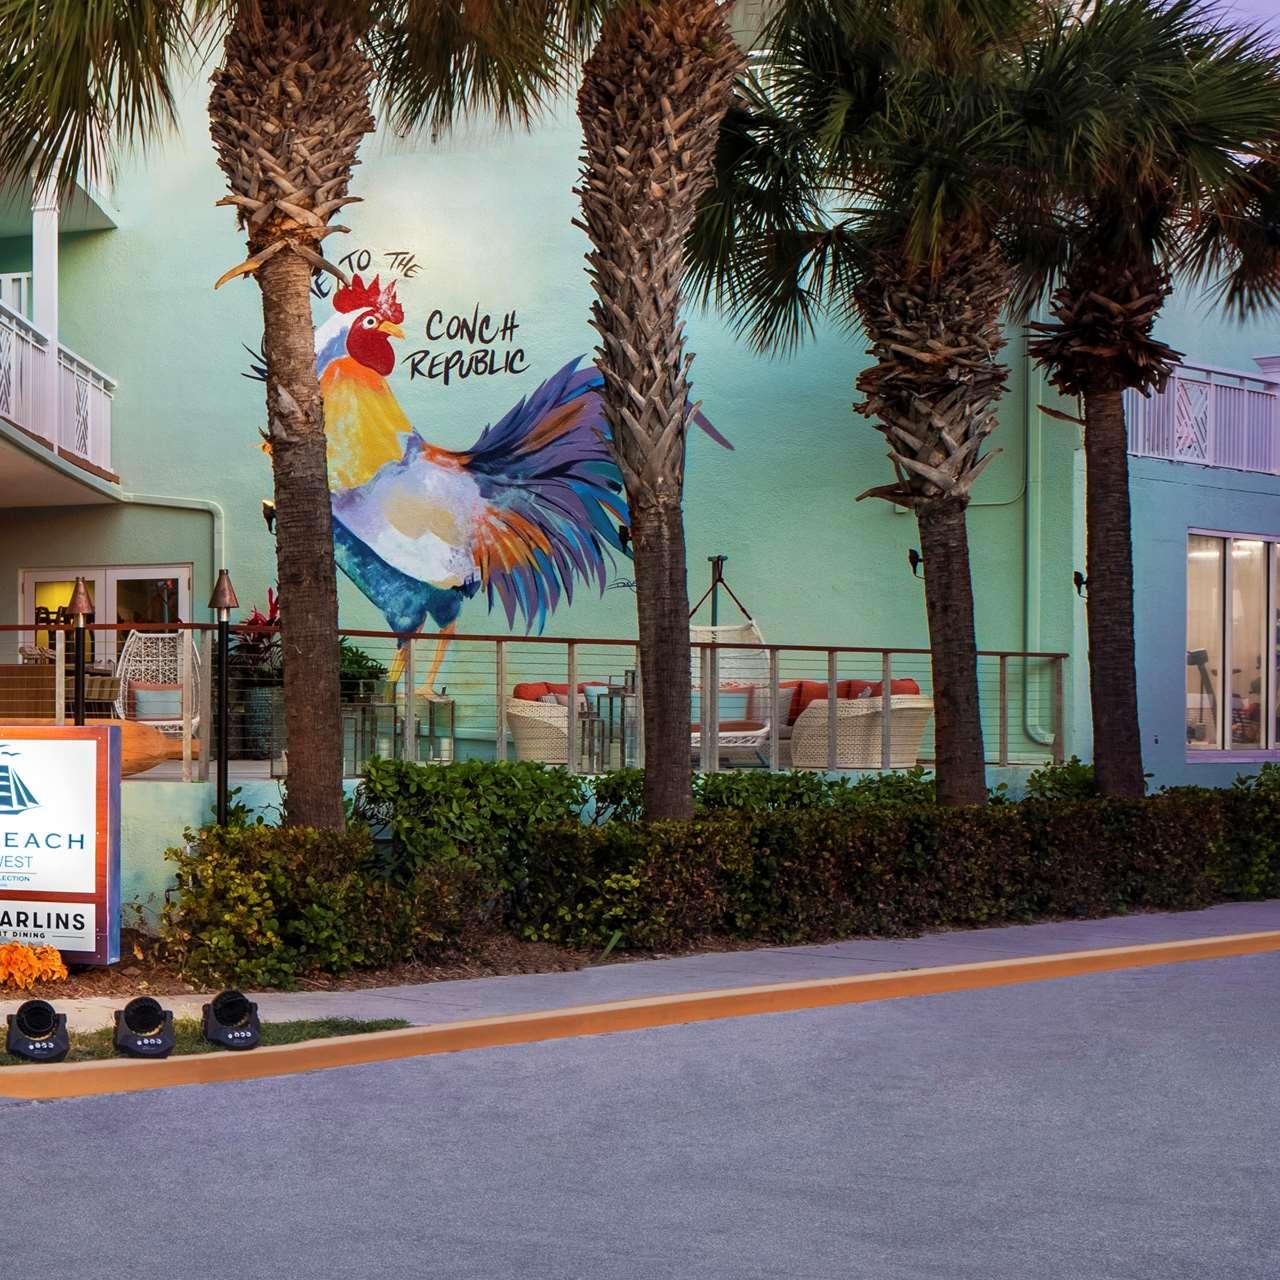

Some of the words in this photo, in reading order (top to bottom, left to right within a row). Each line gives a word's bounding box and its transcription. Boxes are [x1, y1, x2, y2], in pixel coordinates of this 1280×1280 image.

[339, 249, 371, 273] TO
[384, 251, 424, 278] THE
[426, 302, 520, 344] CONCH
[402, 348, 531, 386] REPUBLIC
[12, 931, 46, 939] DINING
